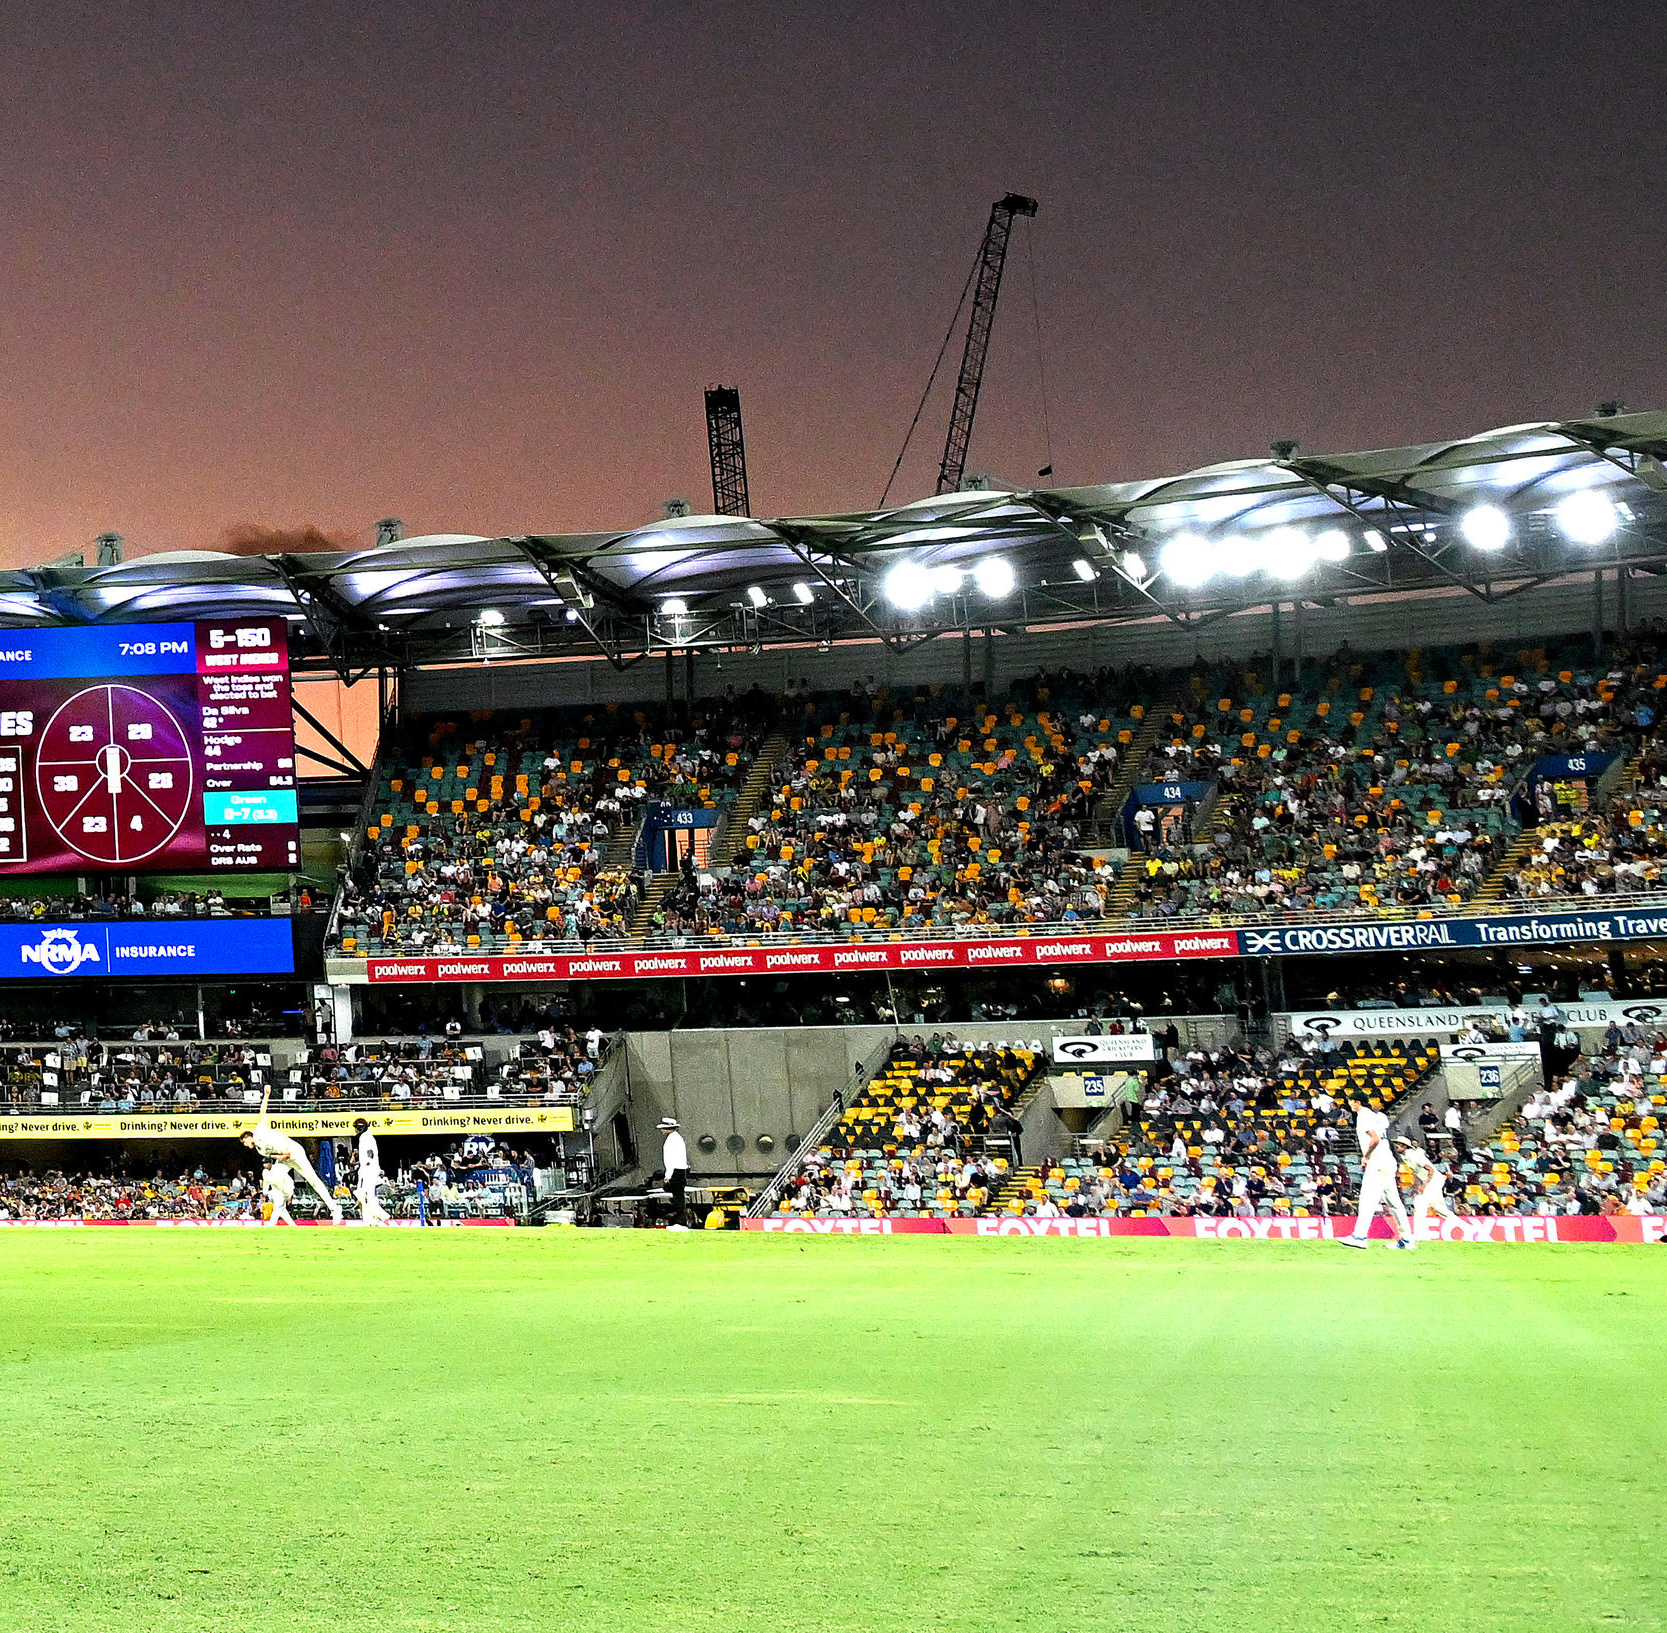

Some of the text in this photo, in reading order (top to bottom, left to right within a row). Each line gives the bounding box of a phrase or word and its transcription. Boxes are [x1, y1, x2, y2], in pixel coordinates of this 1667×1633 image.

[119, 641, 188, 656] 7:08 PM
[213, 683, 230, 691] the
[255, 682, 274, 690] and
[248, 691, 259, 699] to
[261, 690, 278, 698] bat
[202, 706, 219, 715] Da
[69, 725, 94, 742] 23
[204, 735, 242, 746] Hodge
[206, 761, 263, 771] Partnership
[1568, 758, 1586, 770] 435
[206, 779, 232, 787] Over
[1164, 786, 1181, 798] 434
[230, 795, 266, 804] Green
[82, 816, 107, 833] 23
[130, 815, 143, 831] 4
[677, 812, 693, 824] 433
[210, 844, 262, 853] Over Rate
[235, 856, 258, 865] AUS
[1476, 919, 1612, 942] Transforming
[1105, 938, 1161, 956] poolwerx
[1174, 935, 1231, 954] poolwerx
[21, 944, 196, 964] NRMA INSURANCE
[766, 951, 819, 968] poolwerx
[901, 947, 955, 964] poolwerx
[968, 945, 1023, 962] poolwerx
[374, 962, 426, 979] poolwerx
[503, 960, 556, 977] poolwerx
[634, 956, 687, 974] poolwerx
[1353, 1013, 1459, 1030] QUEENSLAND
[1567, 1009, 1608, 1023] CLUB
[1481, 1070, 1499, 1083] 236
[1085, 1079, 1104, 1093] 235
[120, 1121, 229, 1133] Drinking? Never drive.
[421, 1115, 534, 1128] Drinking? Never drive.
